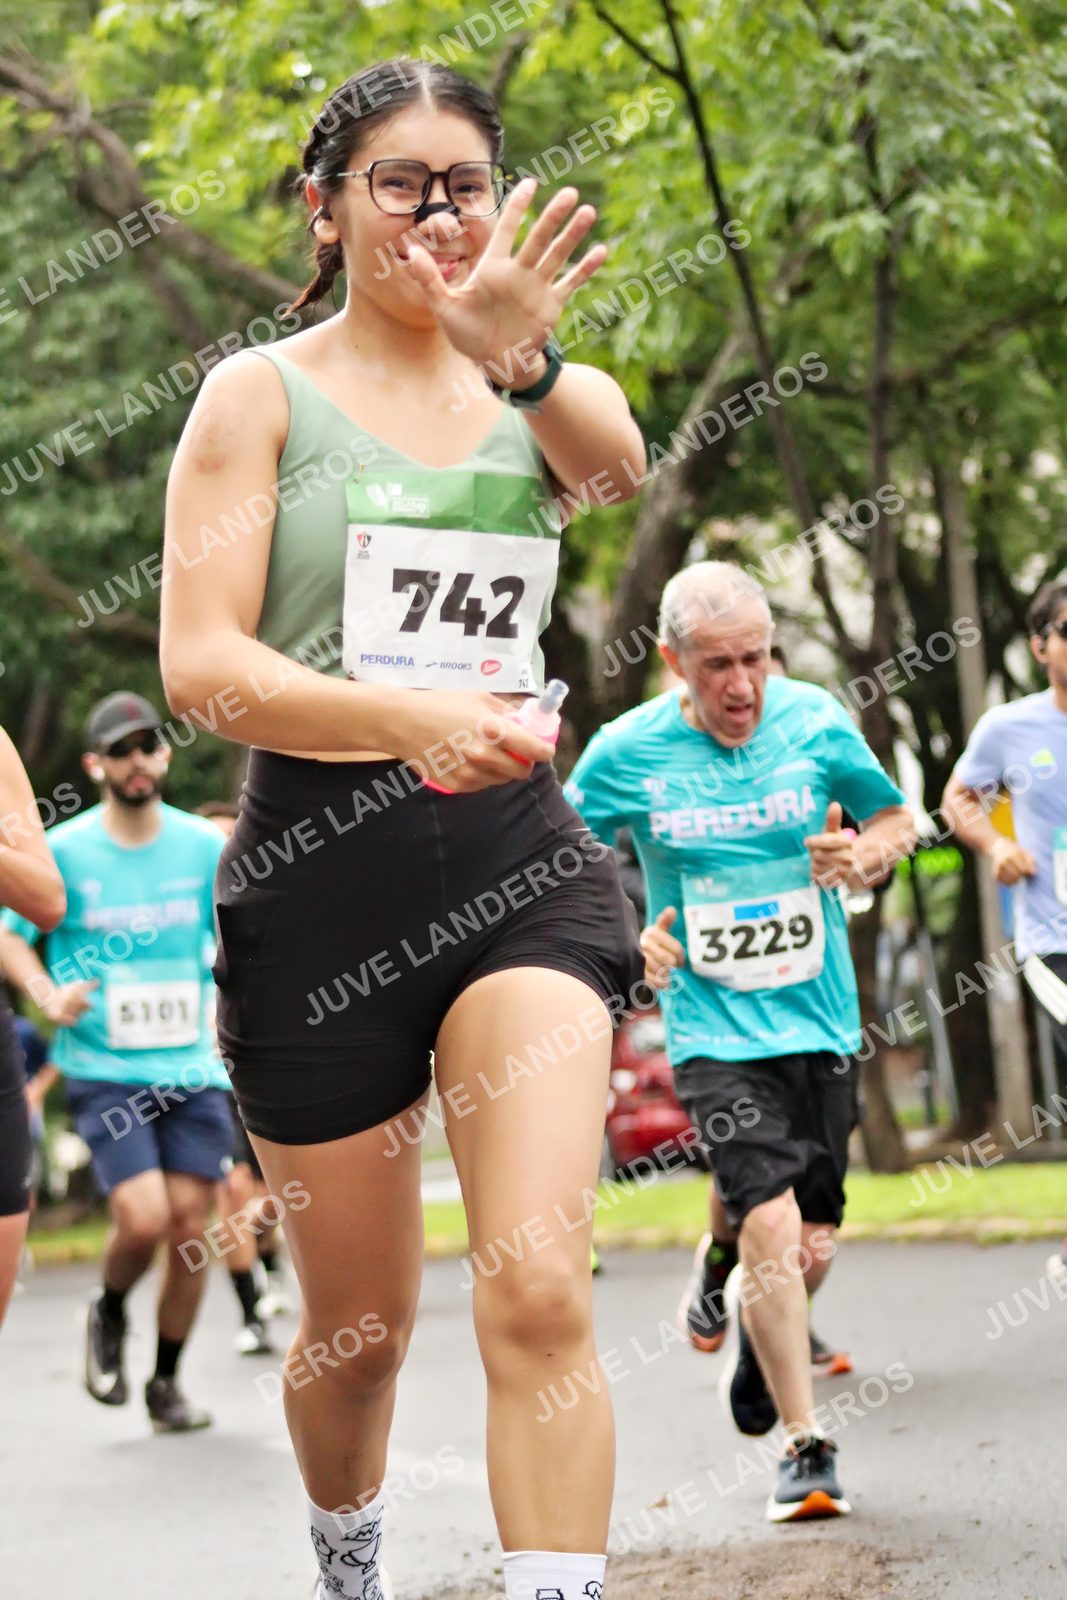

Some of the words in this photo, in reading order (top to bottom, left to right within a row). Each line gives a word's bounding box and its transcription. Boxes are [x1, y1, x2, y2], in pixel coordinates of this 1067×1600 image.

[392, 568, 525, 639] 742
[360, 654, 415, 667] PERDURA
[439, 661, 473, 671] BROOKS
[518, 678, 529, 689] 742
[651, 785, 816, 840] PERDURA
[699, 914, 814, 963] 3229
[120, 1000, 190, 1023] 5101
